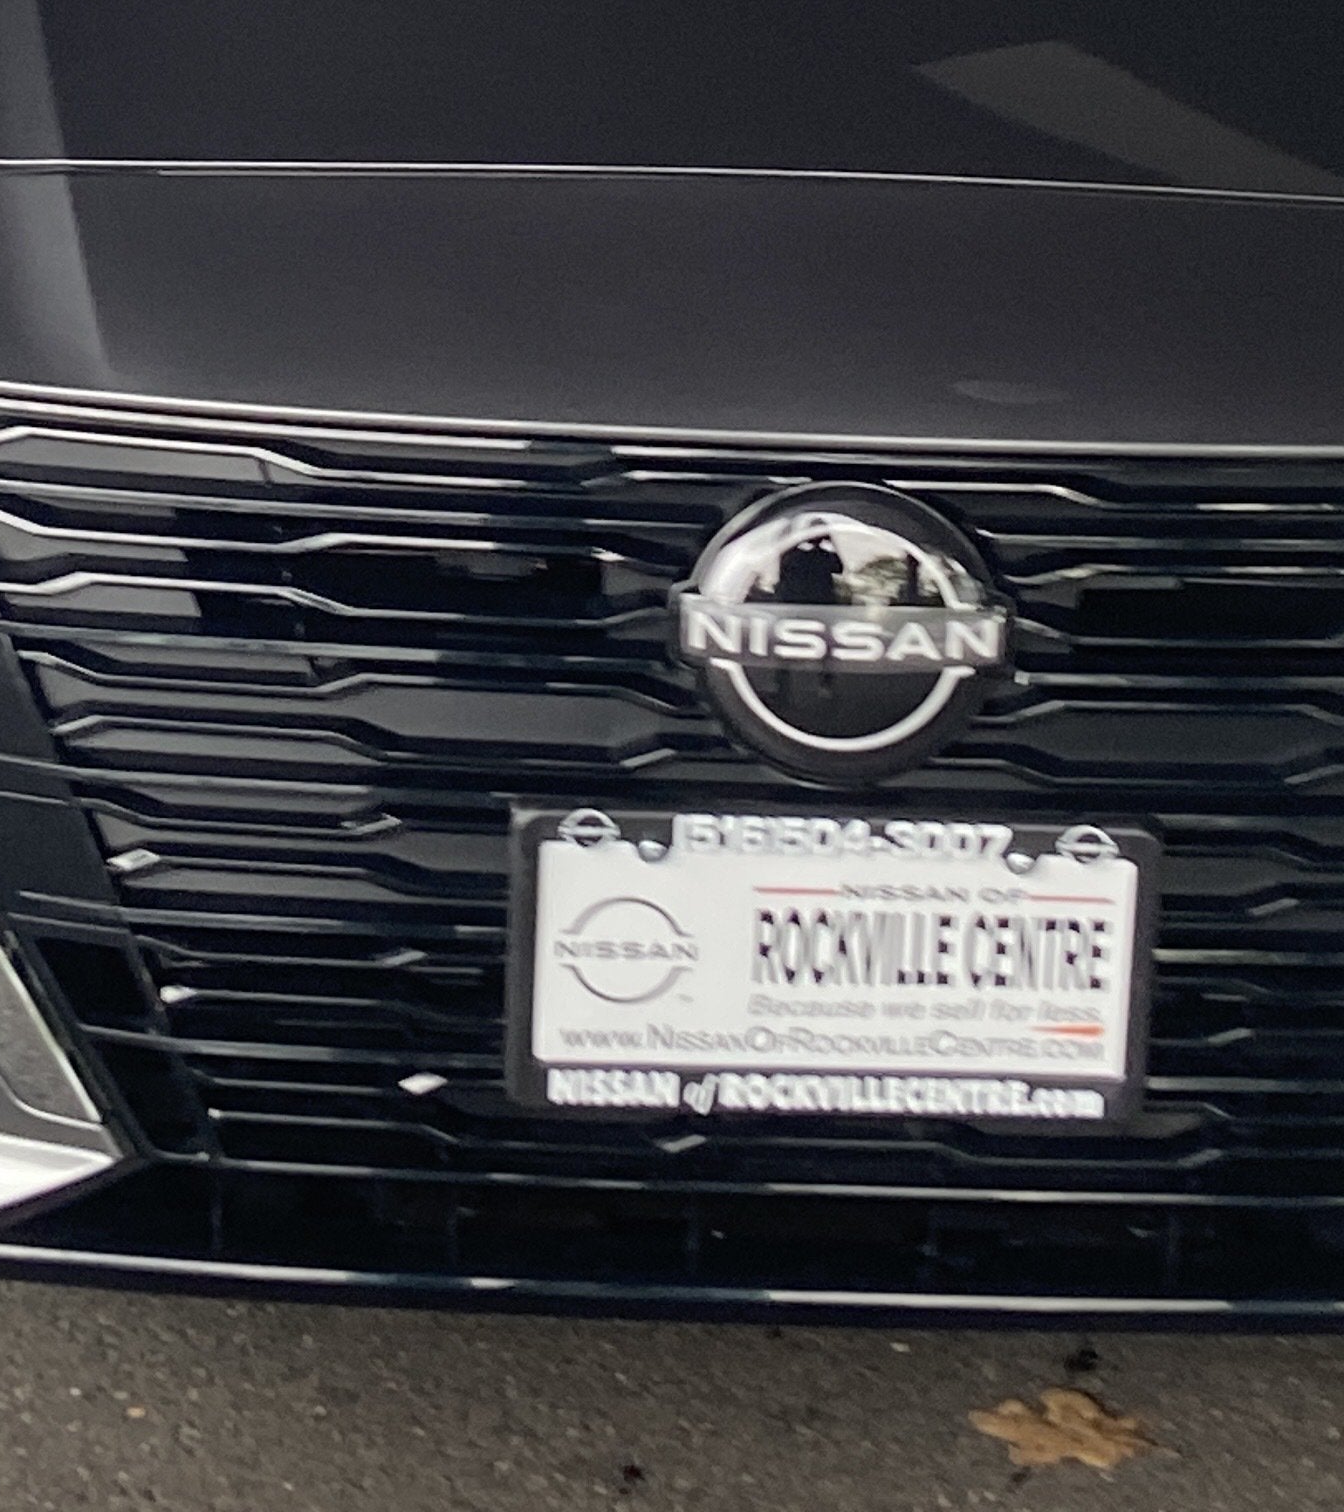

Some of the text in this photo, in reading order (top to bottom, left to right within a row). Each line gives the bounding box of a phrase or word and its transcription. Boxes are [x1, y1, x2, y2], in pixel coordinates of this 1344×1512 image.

[686, 610, 1001, 661] NISSAN
[839, 882, 971, 903] NISSAN
[554, 939, 699, 962] NISSAN
[750, 907, 1115, 992] ROCKVILLE CENTRE
[546, 1068, 681, 1107] NISSAN
